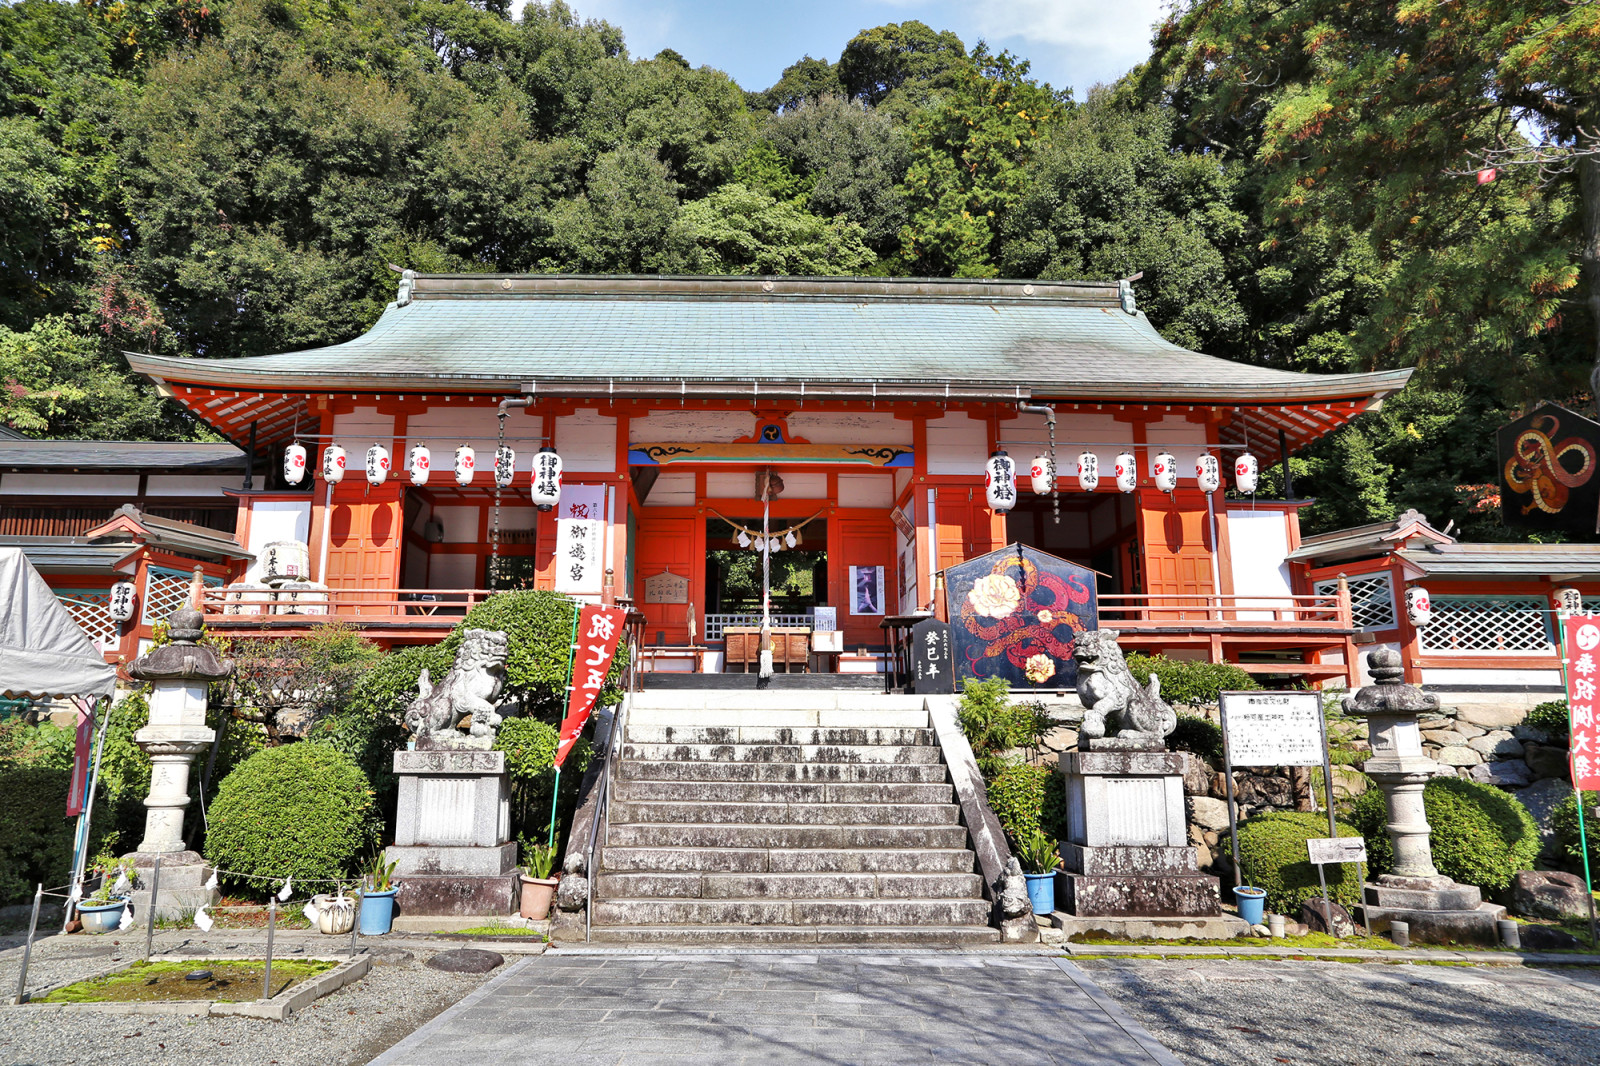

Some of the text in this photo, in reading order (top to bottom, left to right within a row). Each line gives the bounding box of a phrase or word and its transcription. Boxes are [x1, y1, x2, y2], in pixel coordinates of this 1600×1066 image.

[538, 454, 558, 497] 御神燈
[993, 458, 1014, 501] 御神燈
[925, 630, 940, 680] 癸巳年
